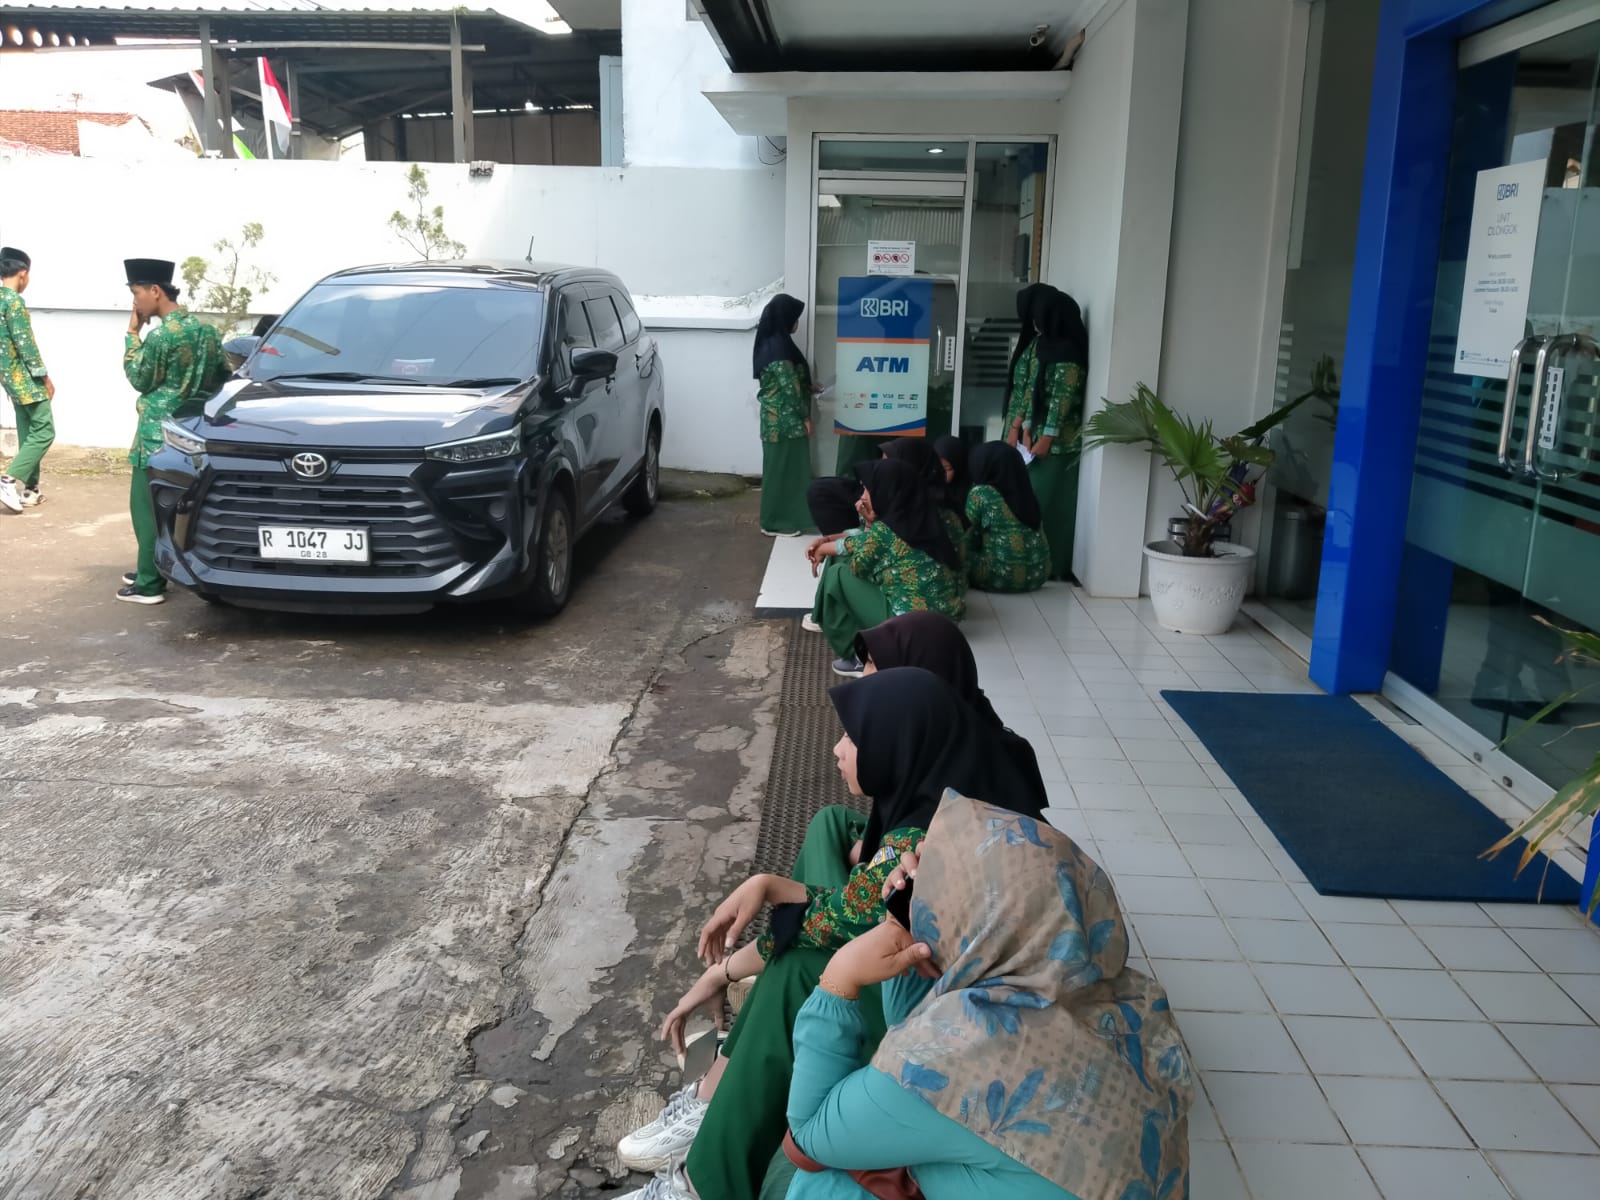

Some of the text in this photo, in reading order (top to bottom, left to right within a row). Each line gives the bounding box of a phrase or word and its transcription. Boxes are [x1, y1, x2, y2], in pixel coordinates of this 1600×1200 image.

[880, 300, 909, 317] BRI
[856, 356, 910, 373] ATM
[262, 530, 364, 550] R 1047 JJ
